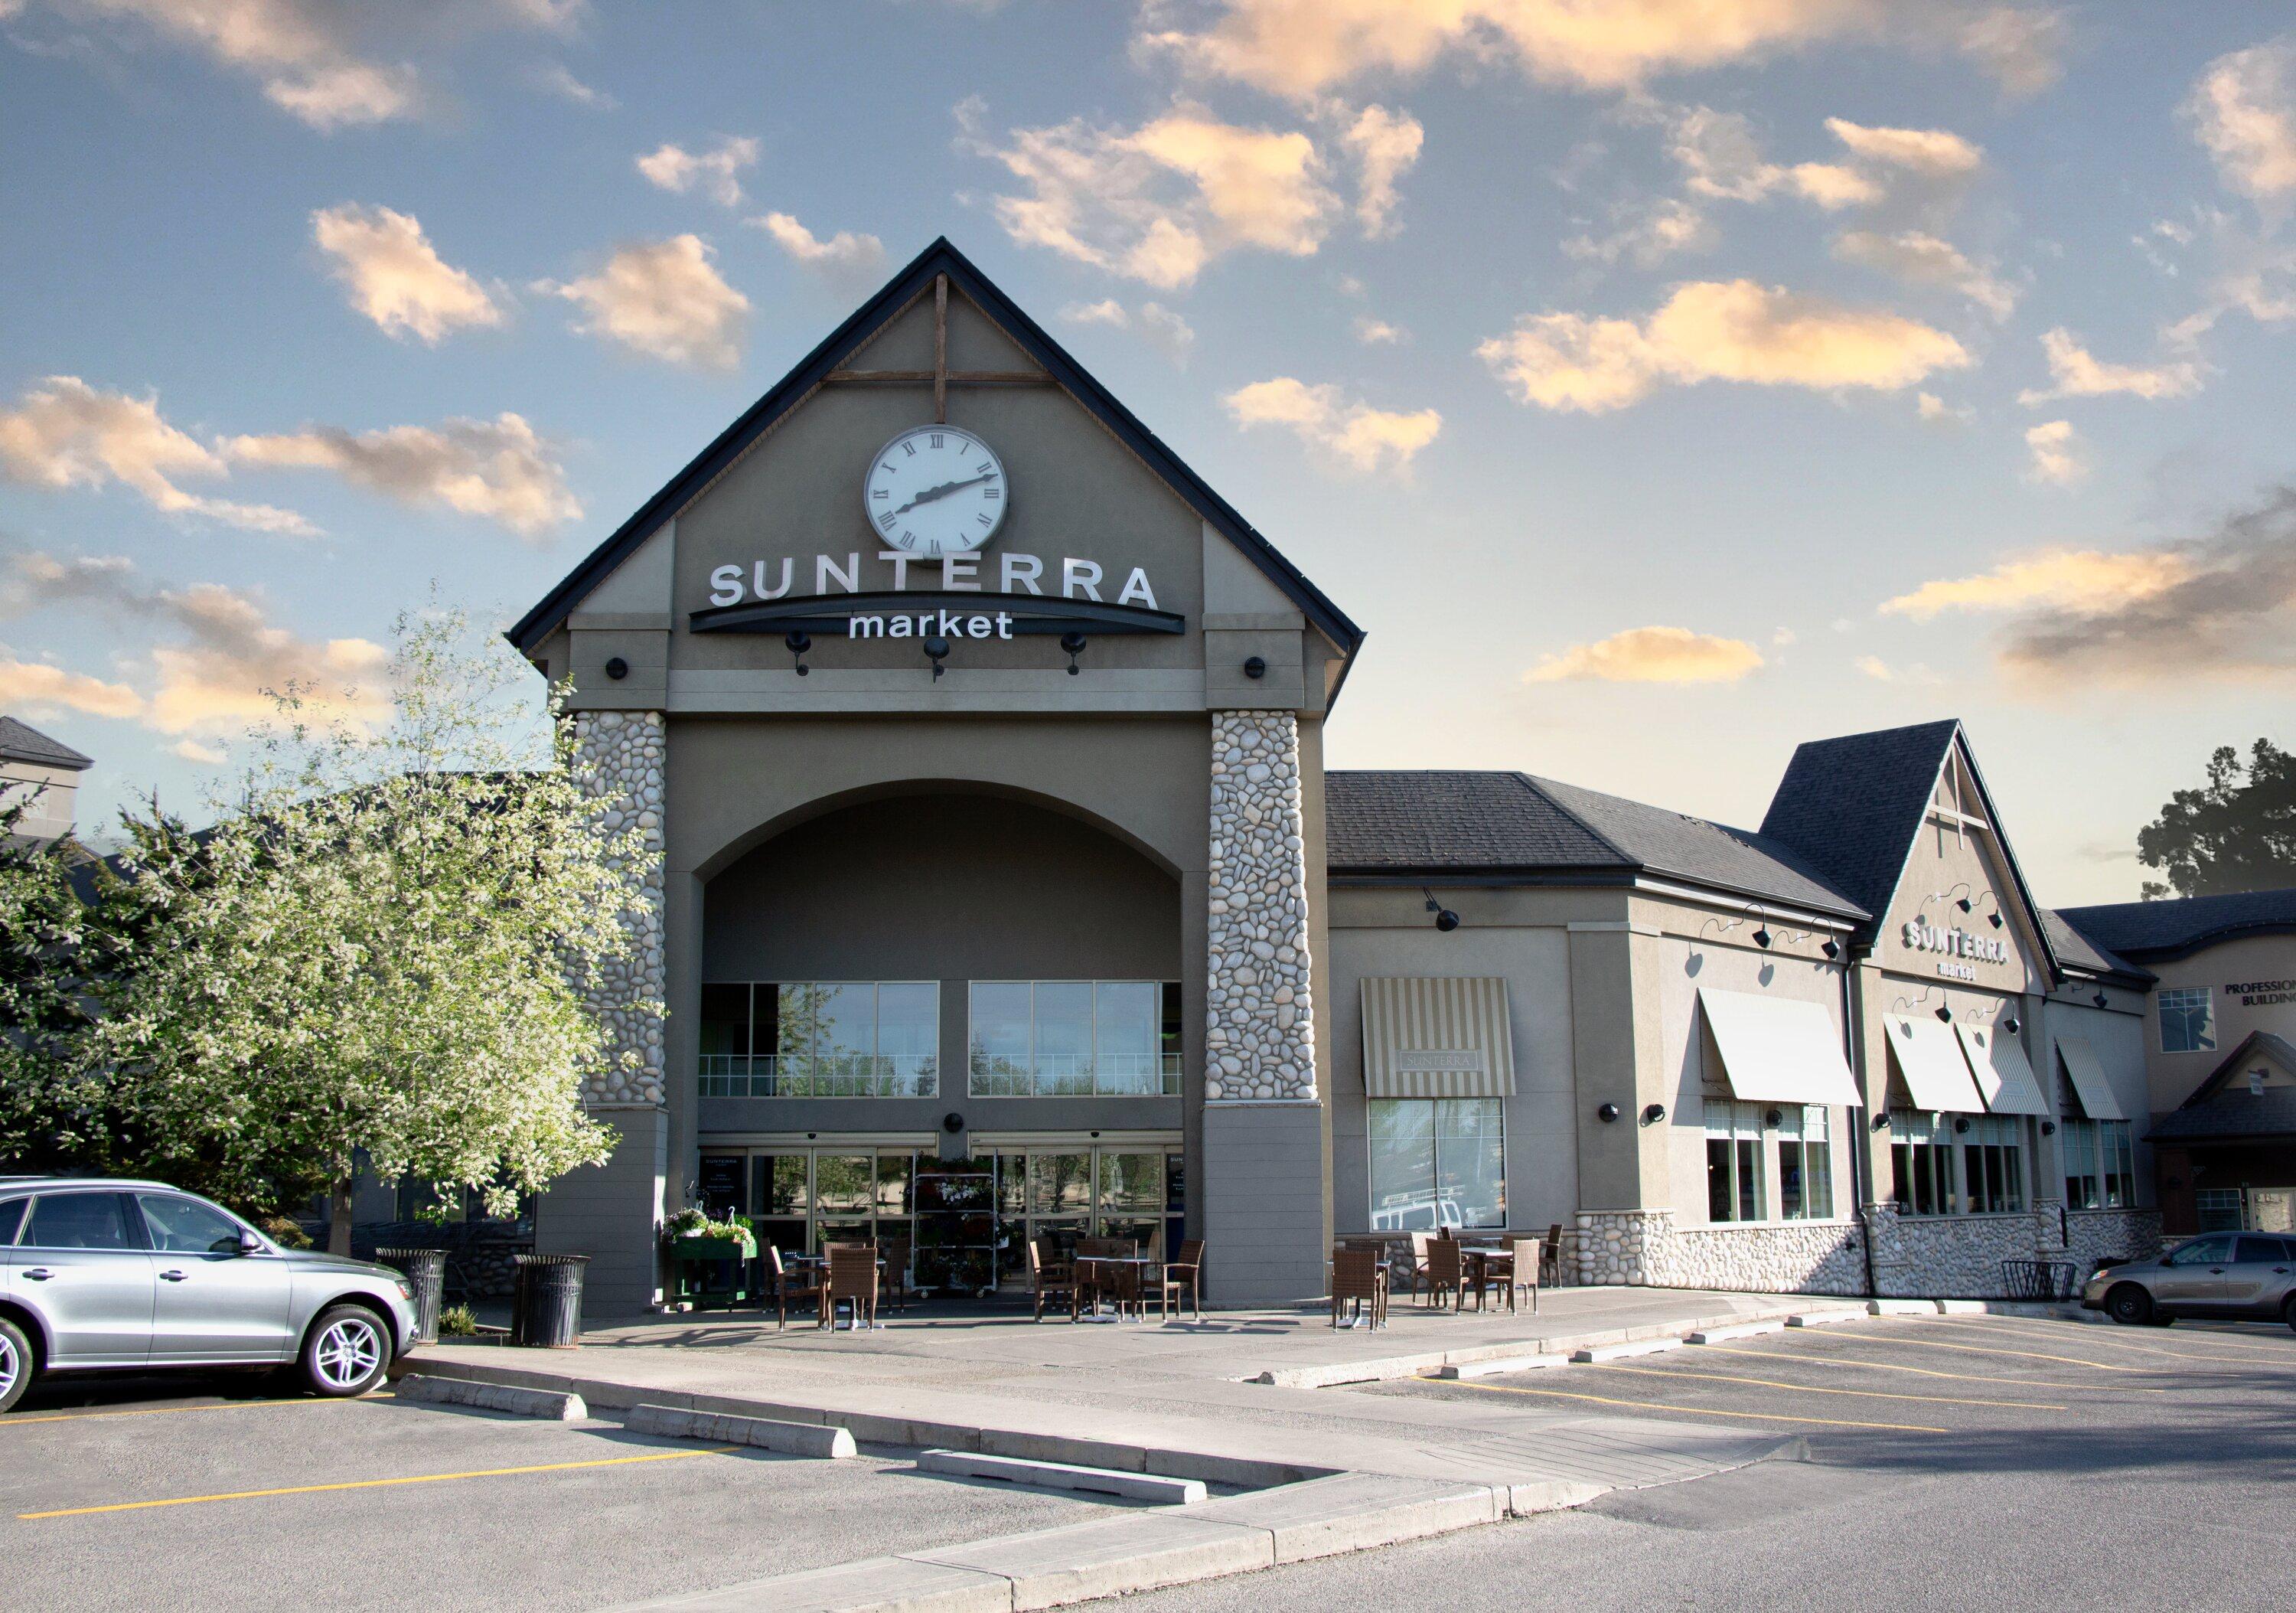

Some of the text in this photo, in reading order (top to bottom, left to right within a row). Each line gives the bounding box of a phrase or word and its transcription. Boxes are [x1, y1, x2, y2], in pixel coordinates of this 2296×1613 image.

[902, 441, 916, 456] XI
[930, 434, 944, 448] XII
[873, 489, 889, 498] IX
[984, 488, 999, 498] III
[709, 550, 1159, 611] SUNTERRA
[849, 609, 1013, 640] market
[1906, 921, 2010, 963] SUNTERRA
[1938, 962, 1976, 981] market
[1407, 1055, 1470, 1066] SUNTERRA
